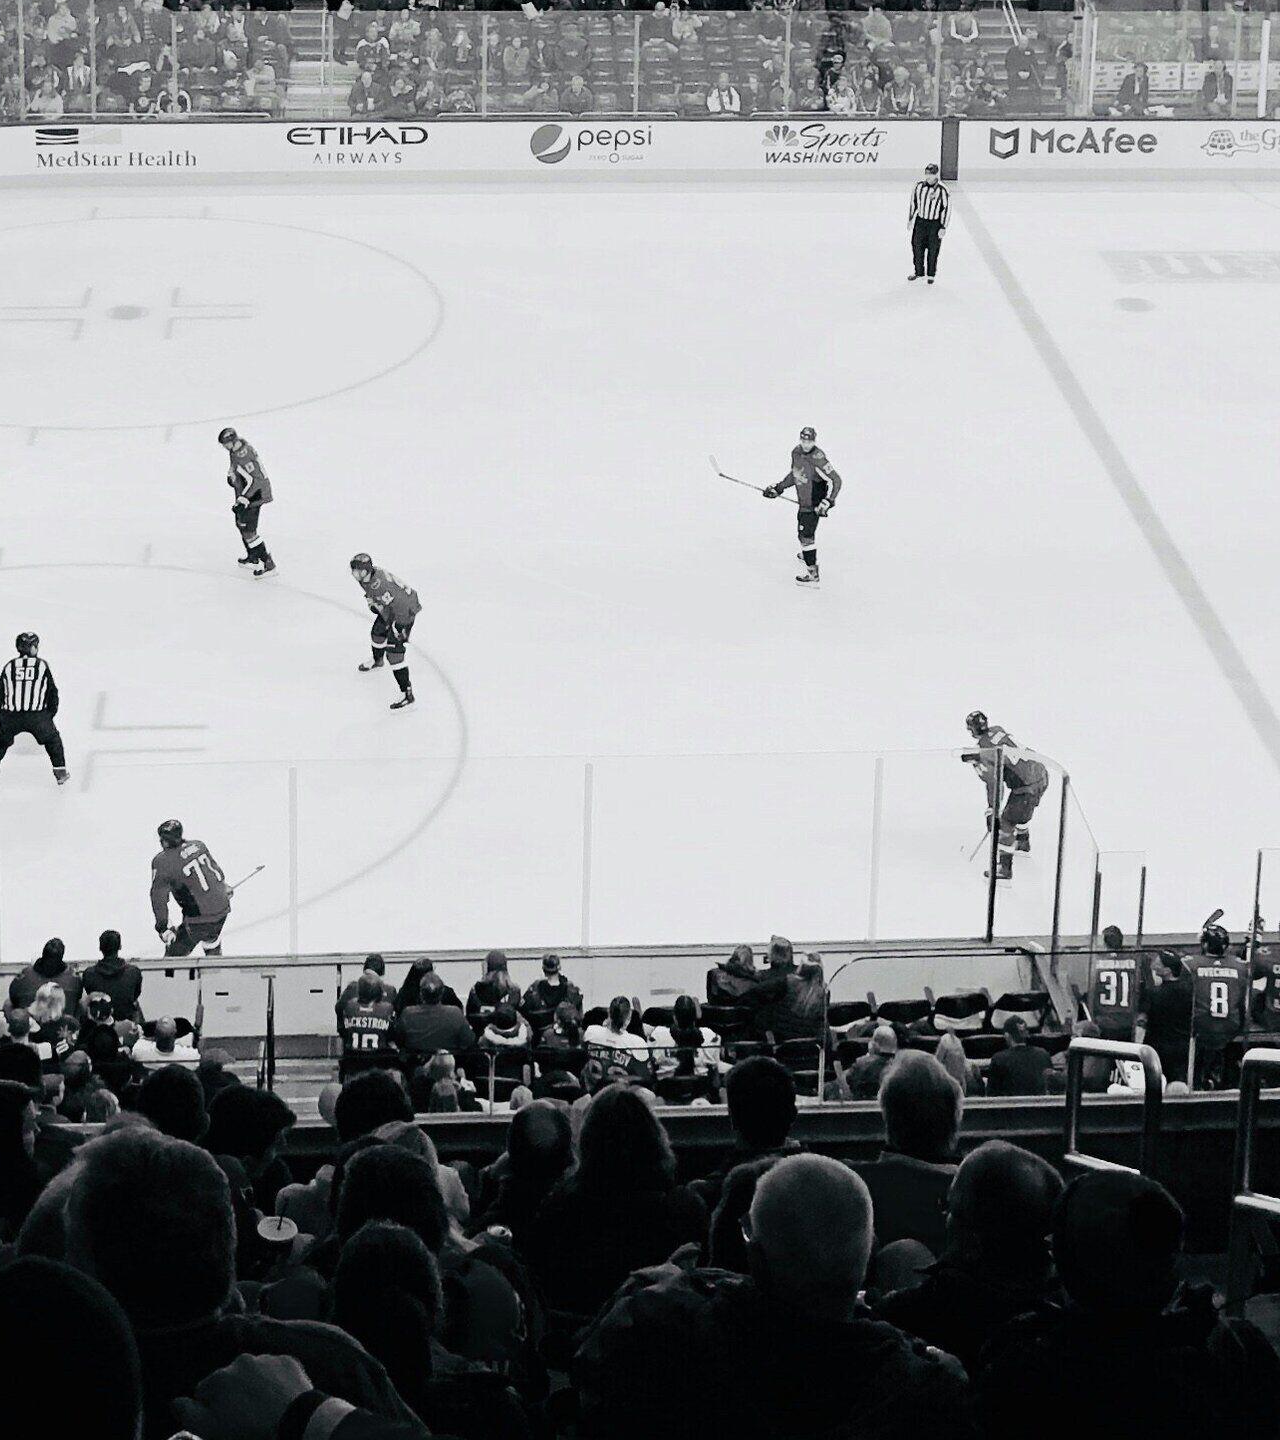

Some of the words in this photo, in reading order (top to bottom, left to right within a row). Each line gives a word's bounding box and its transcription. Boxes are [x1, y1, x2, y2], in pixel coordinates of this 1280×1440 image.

[286, 125, 429, 145] ETIHAD
[577, 123, 653, 152] pepsi
[799, 123, 888, 152] Sports
[1029, 126, 1158, 155] McAfee
[1239, 129, 1260, 141] the
[36, 149, 125, 168] MedStar
[128, 149, 198, 168] Health
[312, 152, 403, 164] AIRWAYS
[764, 151, 879, 164] WASHINGTON
[14, 666, 35, 682] 50
[182, 853, 223, 892] 77
[1099, 970, 1130, 1007] 31
[1209, 981, 1229, 1019] 8
